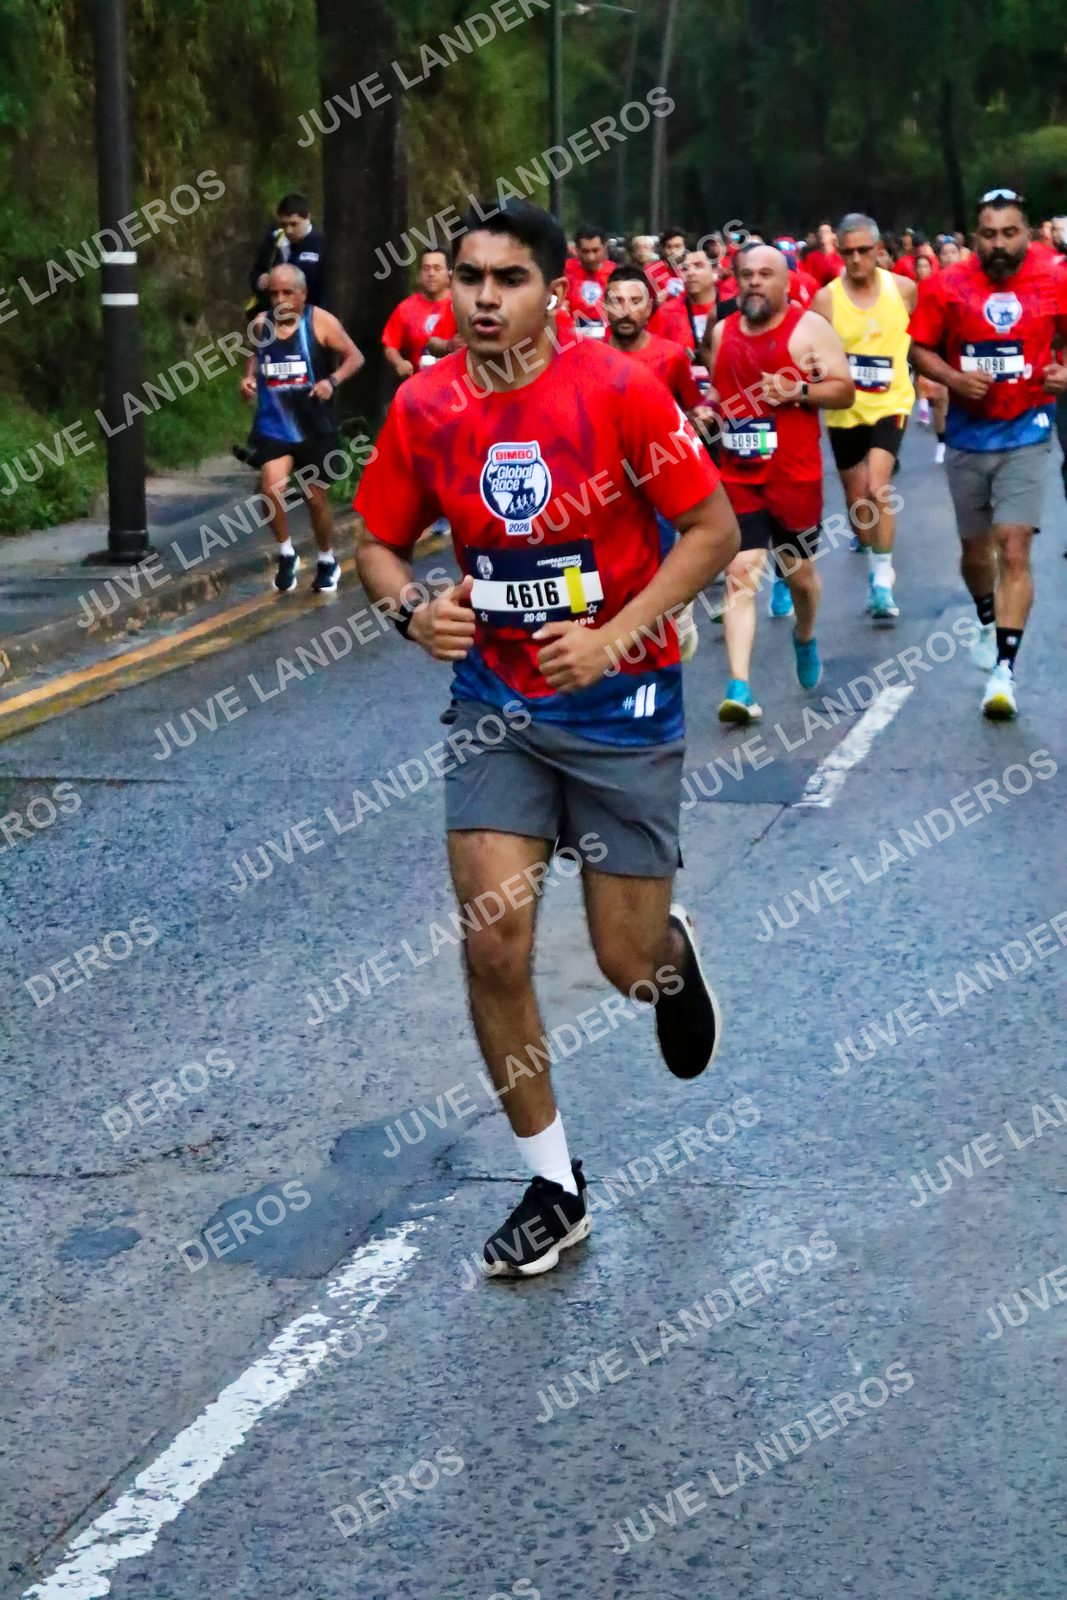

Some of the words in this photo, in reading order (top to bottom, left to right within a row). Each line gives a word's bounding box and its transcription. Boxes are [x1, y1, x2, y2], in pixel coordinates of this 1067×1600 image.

[496, 450, 533, 460] BIMBO
[497, 464, 534, 479] Global
[491, 479, 520, 492] Race
[508, 523, 530, 532] 2026
[506, 580, 560, 608] 4616
